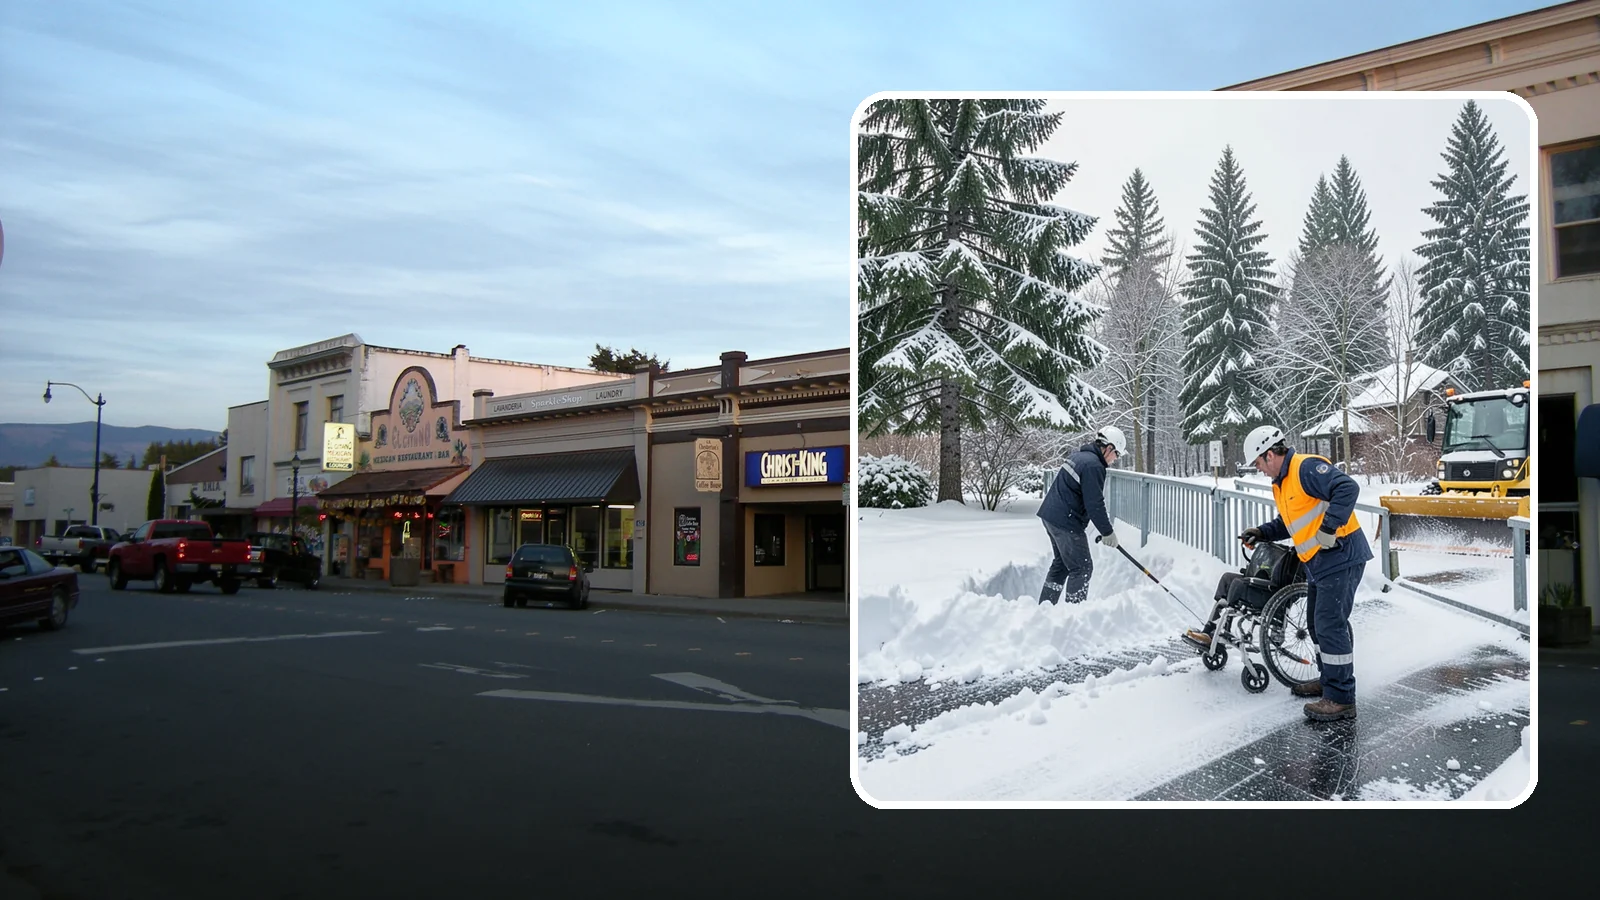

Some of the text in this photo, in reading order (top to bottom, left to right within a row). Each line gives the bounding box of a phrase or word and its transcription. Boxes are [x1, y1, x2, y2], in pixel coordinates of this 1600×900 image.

[493, 389, 623, 413] LAVANDERIA Sparkle Shop LAUNDRY
[391, 425, 402, 449] EL
[373, 450, 449, 464] MEXICAN RESTAURANT BAR
[761, 452, 797, 477] CHRIST
[800, 450, 827, 476] KING
[696, 480, 722, 489] Coffee House
